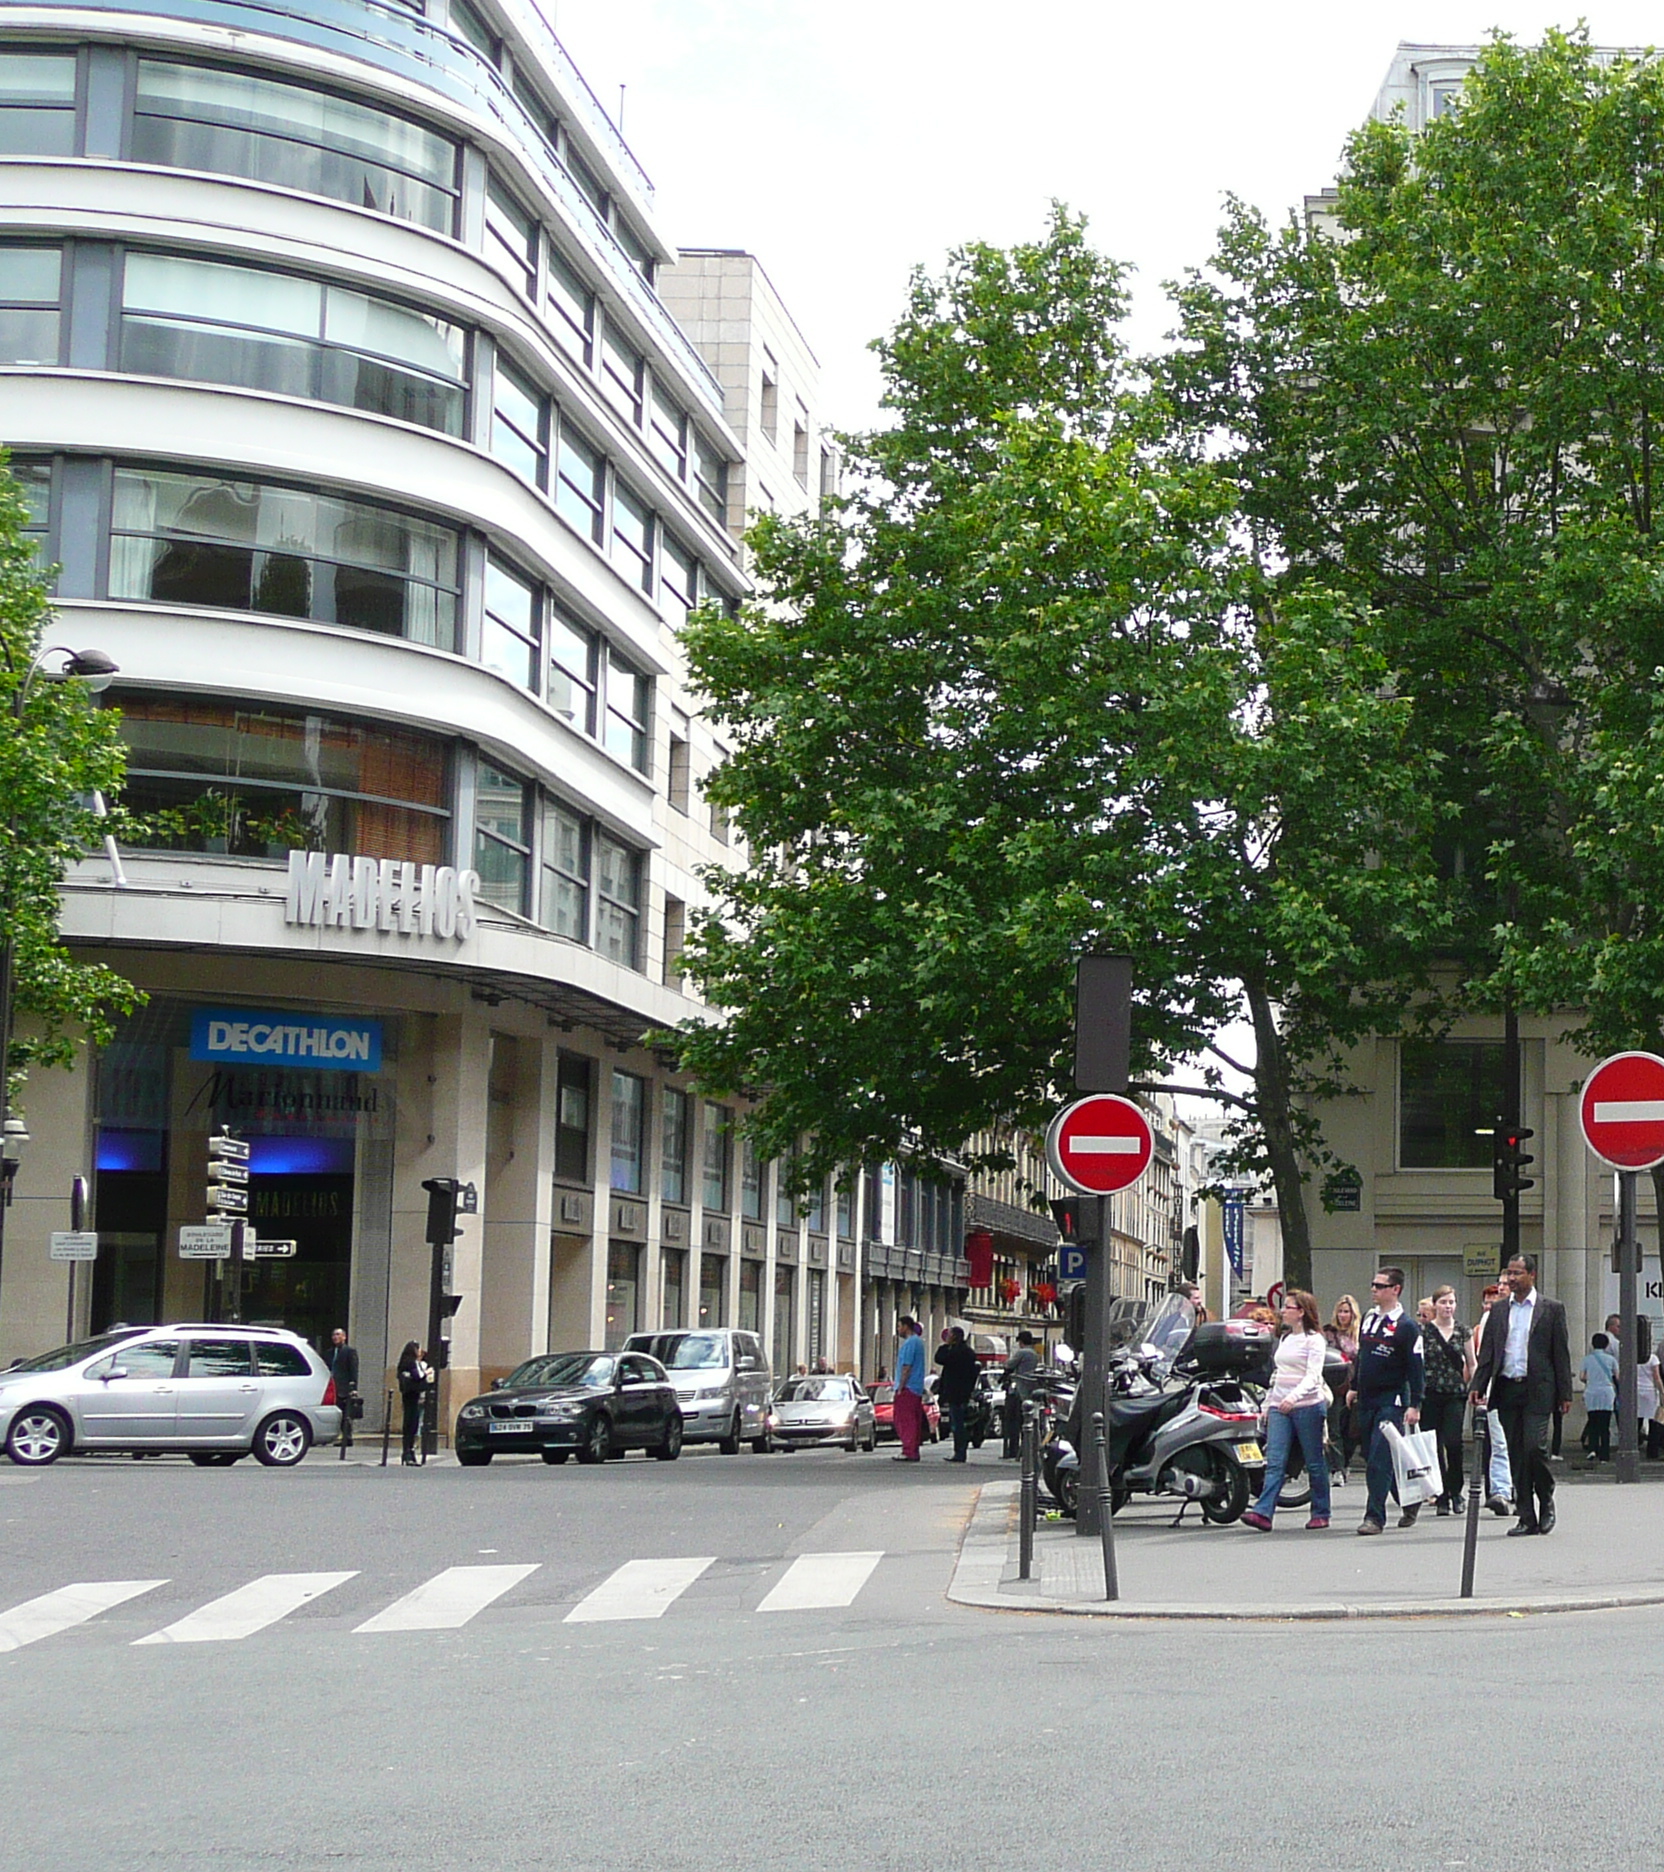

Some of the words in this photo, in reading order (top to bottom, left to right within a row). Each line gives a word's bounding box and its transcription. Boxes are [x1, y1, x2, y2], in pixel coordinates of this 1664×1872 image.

[285, 849, 480, 940] MADELIOS
[208, 1020, 370, 1060] DECATHLON
[180, 1243, 229, 1251] MADELEINE
[1067, 1251, 1084, 1274] P
